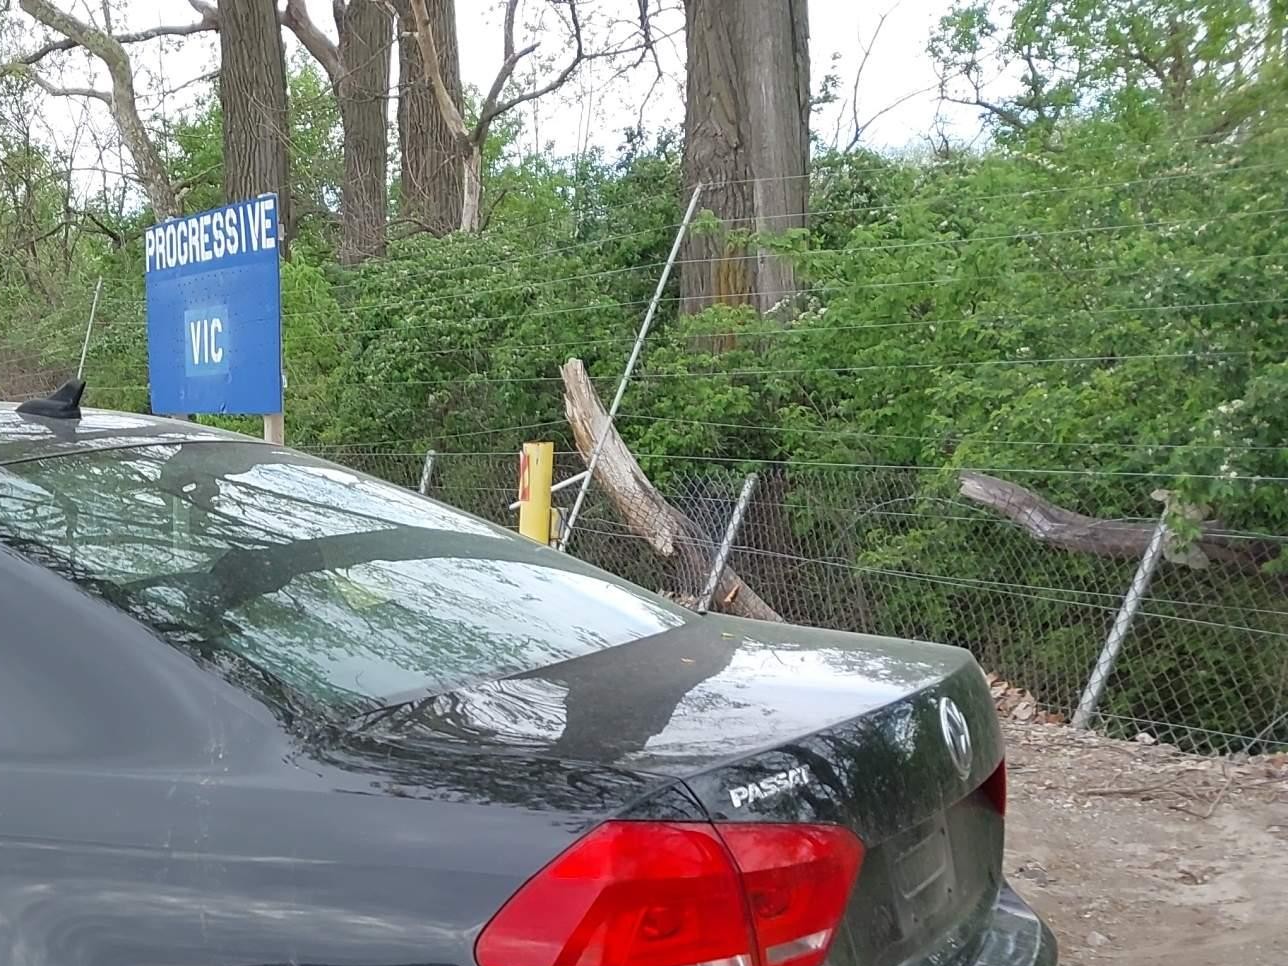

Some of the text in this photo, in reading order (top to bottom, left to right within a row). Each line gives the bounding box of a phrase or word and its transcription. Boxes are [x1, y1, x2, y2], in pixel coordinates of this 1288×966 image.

[145, 200, 275, 272] PROGRESSIVE
[190, 317, 223, 365] VIC
[729, 764, 810, 808] PASSAT
